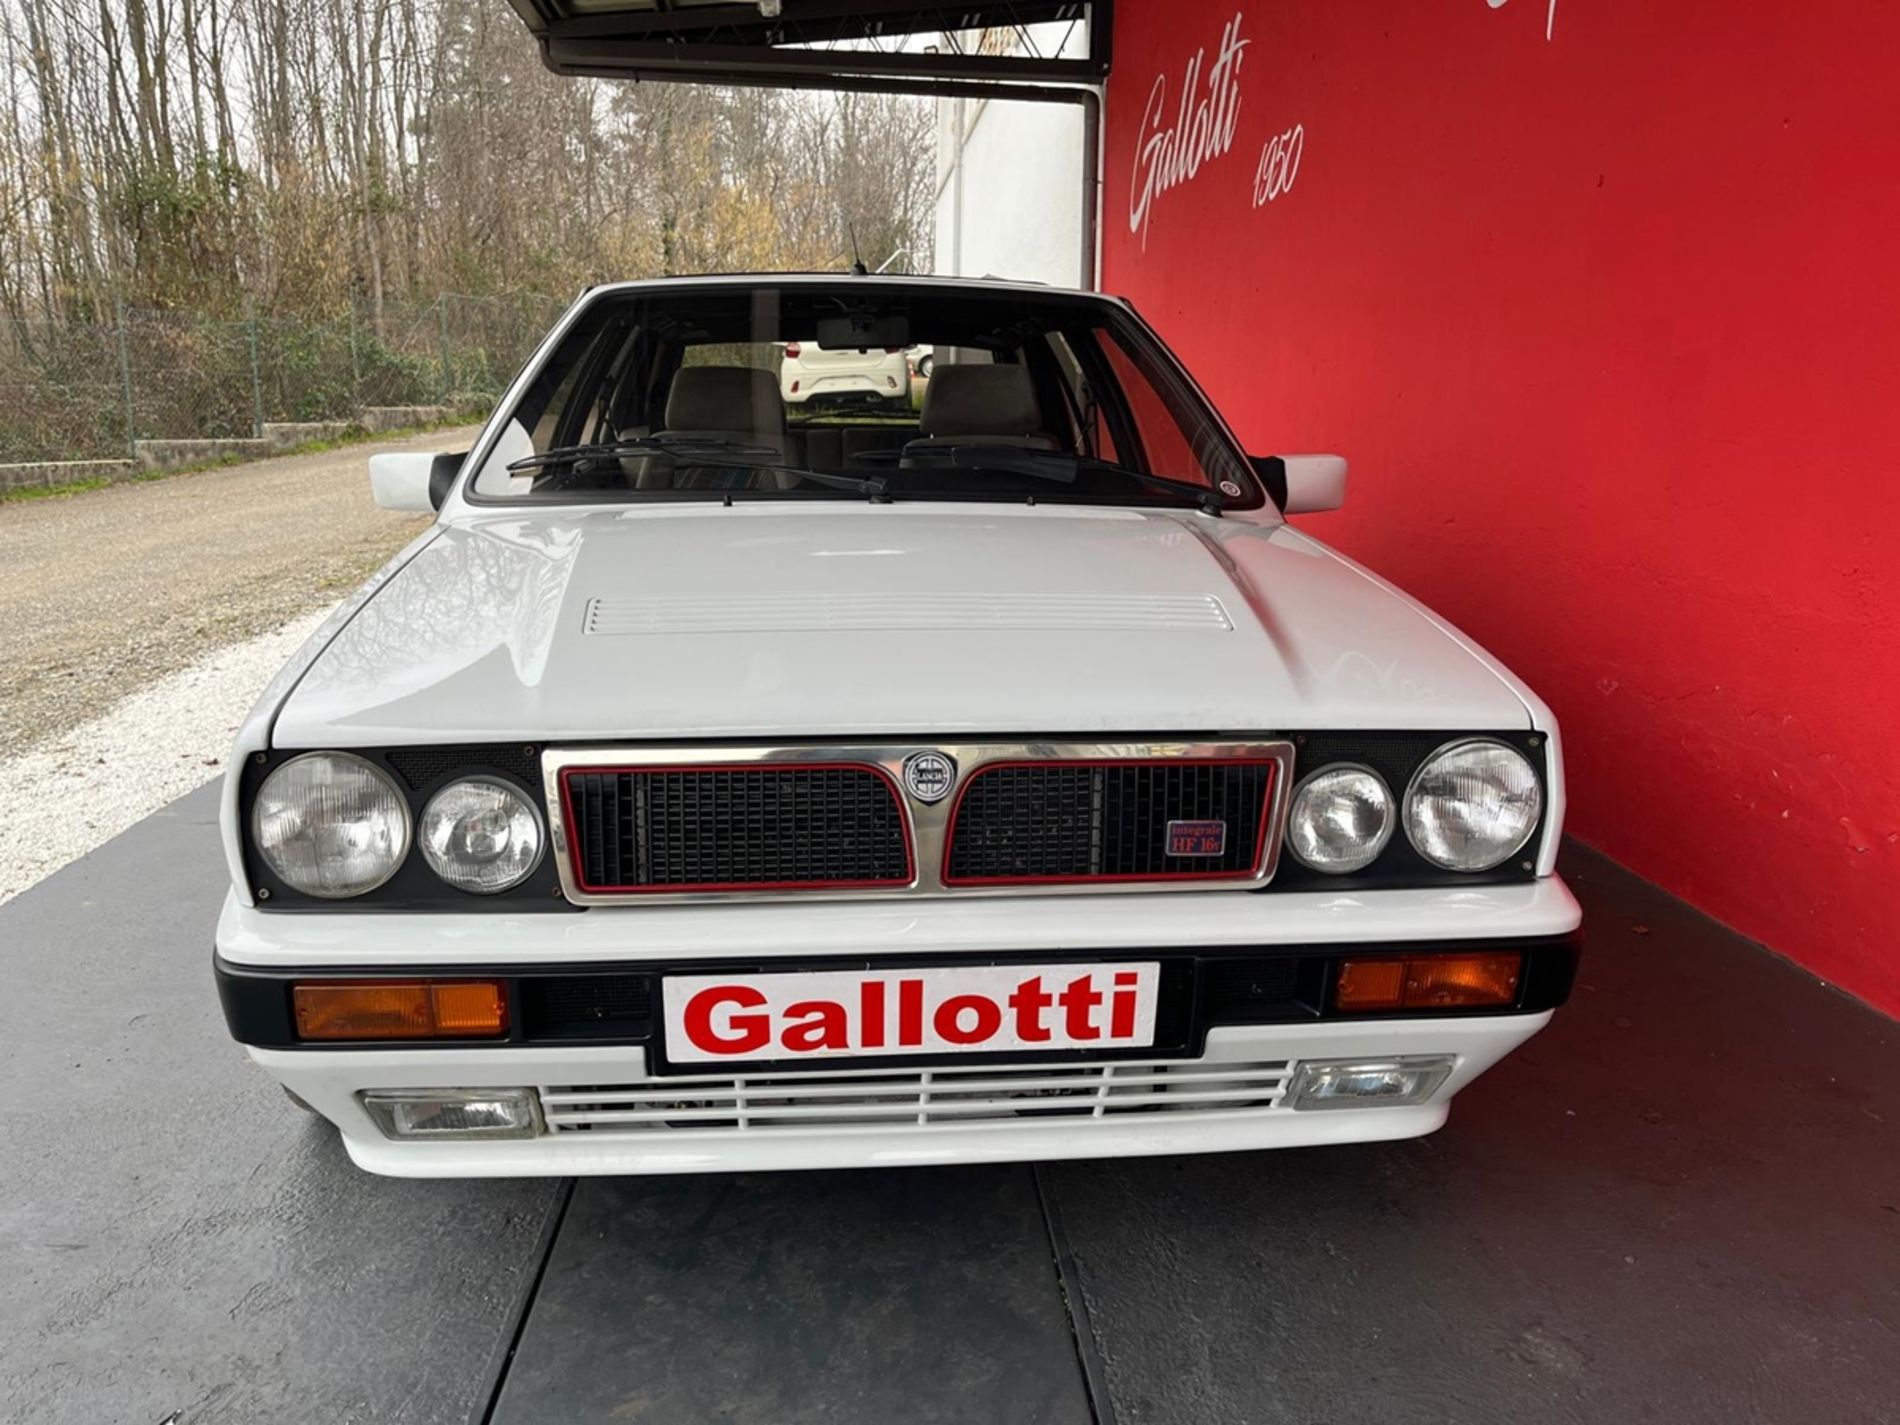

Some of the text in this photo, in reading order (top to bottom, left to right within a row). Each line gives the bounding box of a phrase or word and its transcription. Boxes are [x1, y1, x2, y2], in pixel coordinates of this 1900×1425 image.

[1129, 12, 1252, 253] Gallotti
[1252, 123, 1304, 208] 1950
[916, 771, 943, 781] LANCIA
[1172, 837, 1197, 851] HF
[683, 972, 1139, 1055] Gallotti
